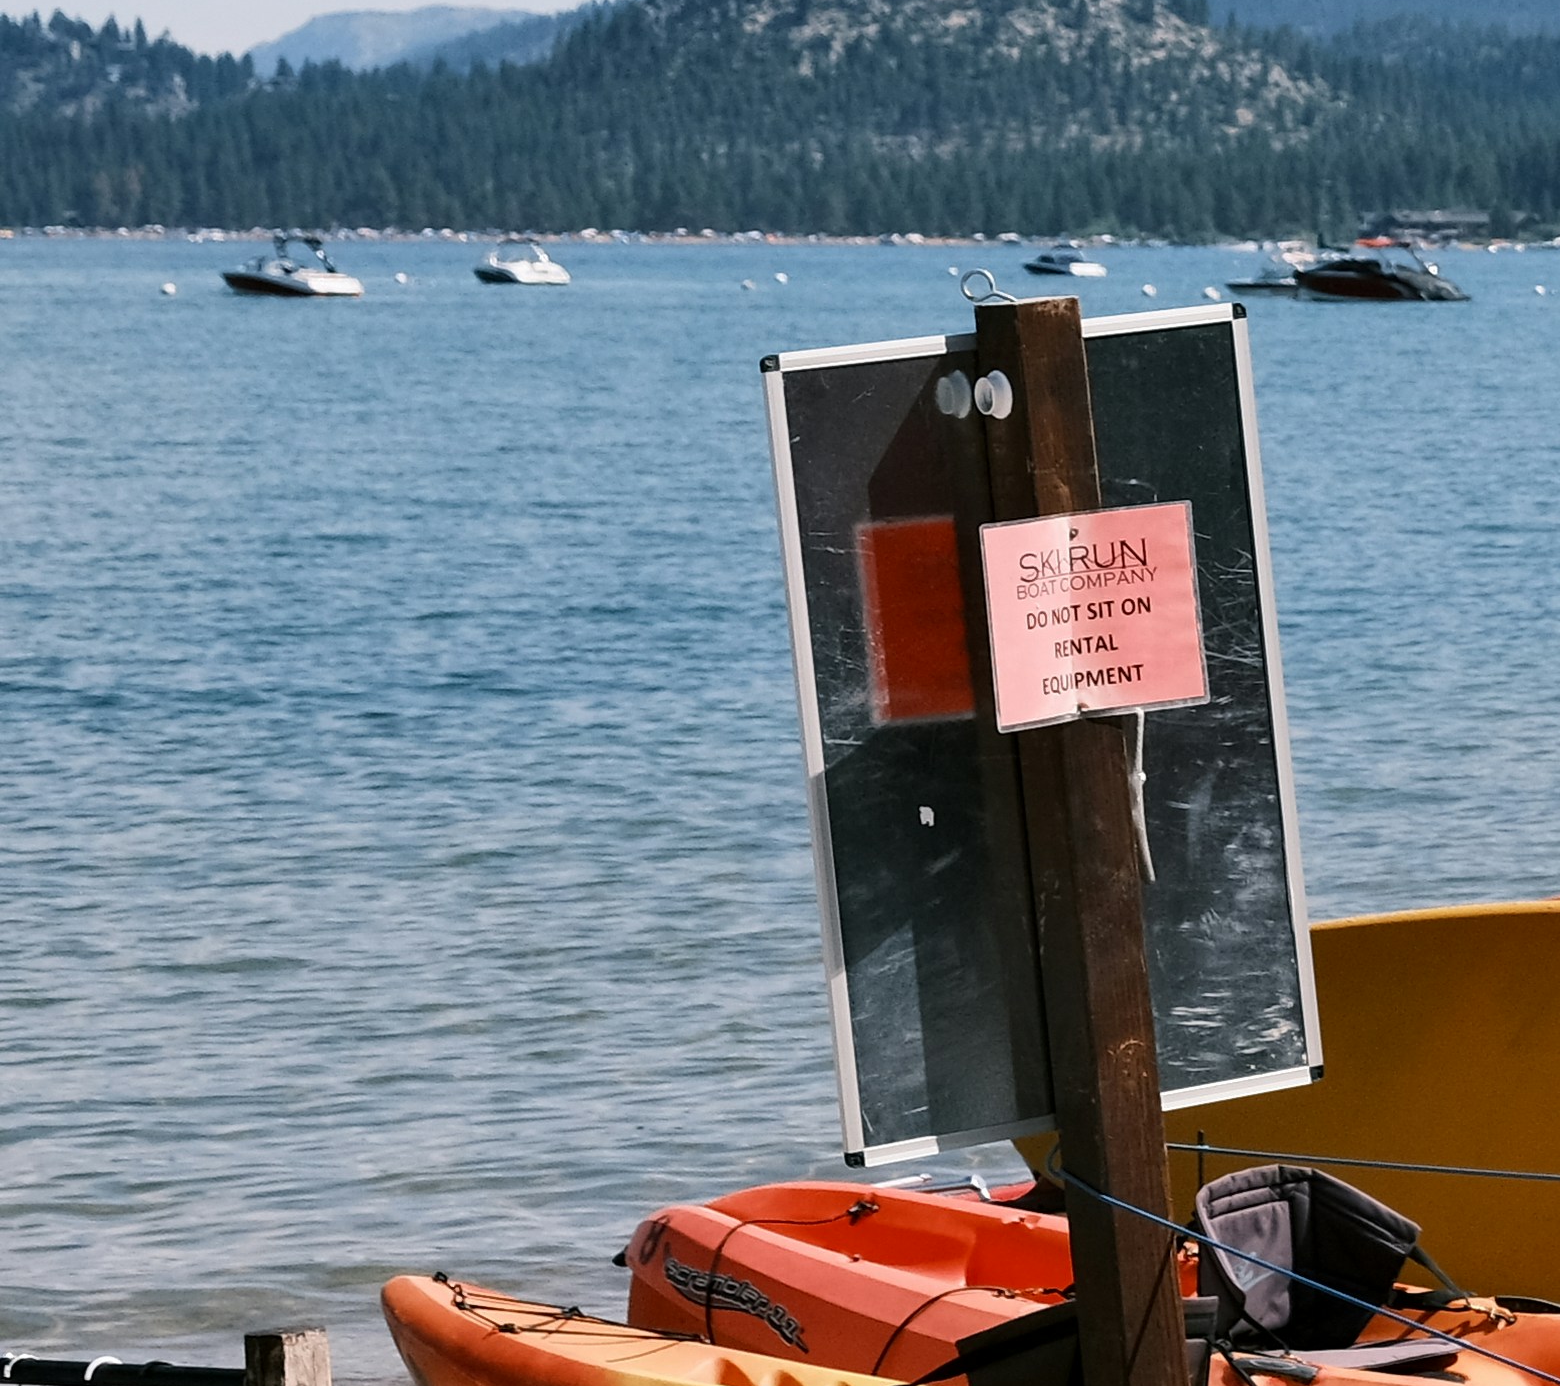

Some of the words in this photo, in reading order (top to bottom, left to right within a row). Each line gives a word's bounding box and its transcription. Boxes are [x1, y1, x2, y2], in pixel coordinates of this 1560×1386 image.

[1019, 549, 1061, 583] SKI
[1069, 538, 1148, 572] RUN
[1016, 580, 1056, 600] BOAT
[1060, 567, 1158, 593] COMPANY
[1026, 611, 1048, 630] DO
[1051, 604, 1081, 625] NOT
[1087, 600, 1115, 620] SIT
[1121, 596, 1151, 616] ON
[1054, 634, 1119, 659] RENTAL
[1042, 664, 1144, 695] EQUIPMENT
